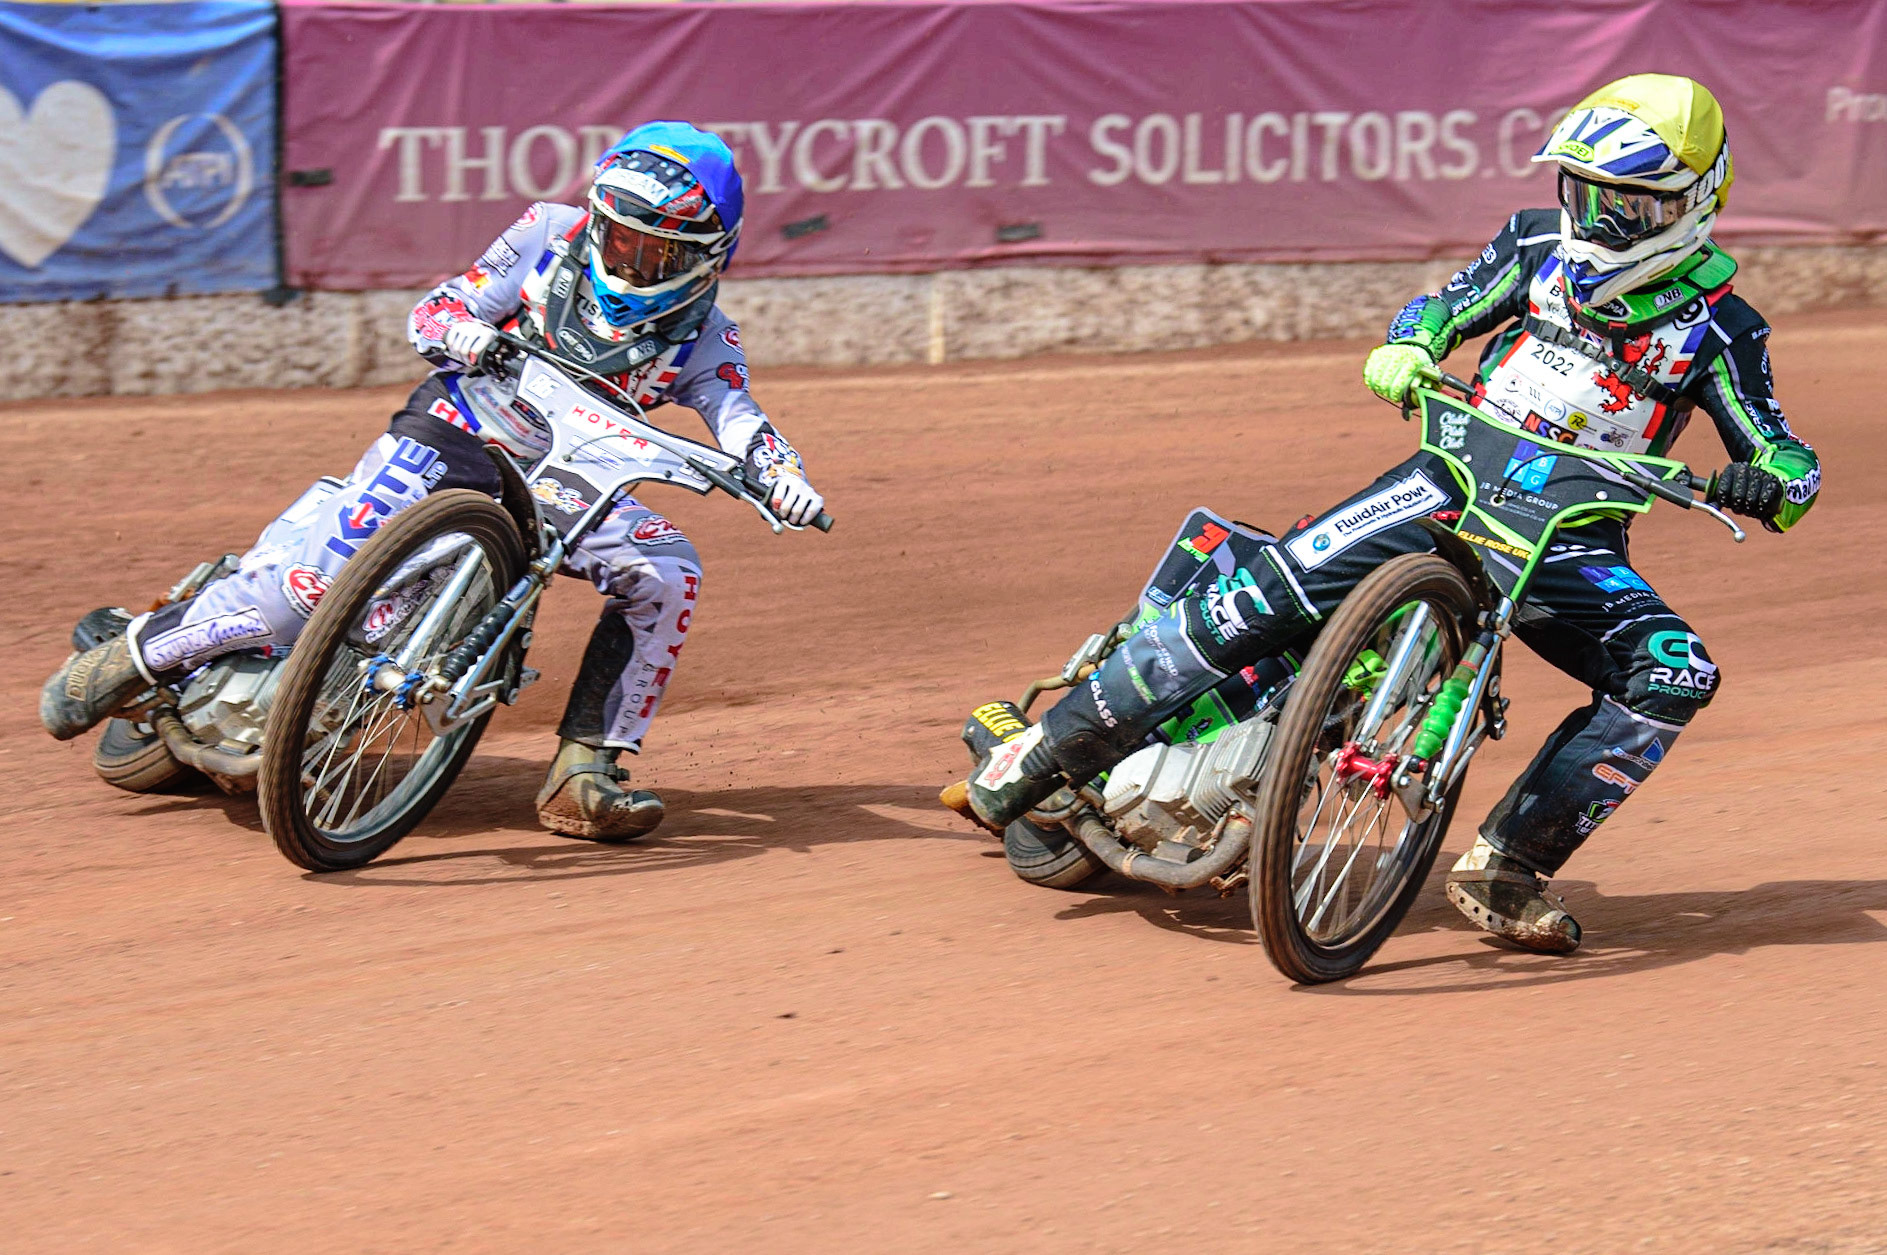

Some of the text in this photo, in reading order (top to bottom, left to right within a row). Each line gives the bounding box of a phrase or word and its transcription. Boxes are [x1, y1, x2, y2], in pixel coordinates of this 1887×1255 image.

[1530, 342, 1575, 377] 2022
[571, 405, 649, 450] HOYER
[1525, 412, 1575, 444] NSSC
[419, 458, 450, 490] LTD
[1335, 498, 1391, 533] FluidAir
[1525, 494, 1559, 512] GROUP
[1457, 529, 1529, 559] ELLIE ROSE UK
[1206, 581, 1240, 642] RACE
[638, 575, 697, 720] HOYER
[1649, 666, 1715, 692] RACE
[617, 662, 659, 737] GROUP
[1089, 680, 1119, 729] GLASS
[971, 701, 1020, 738] ELLIE
